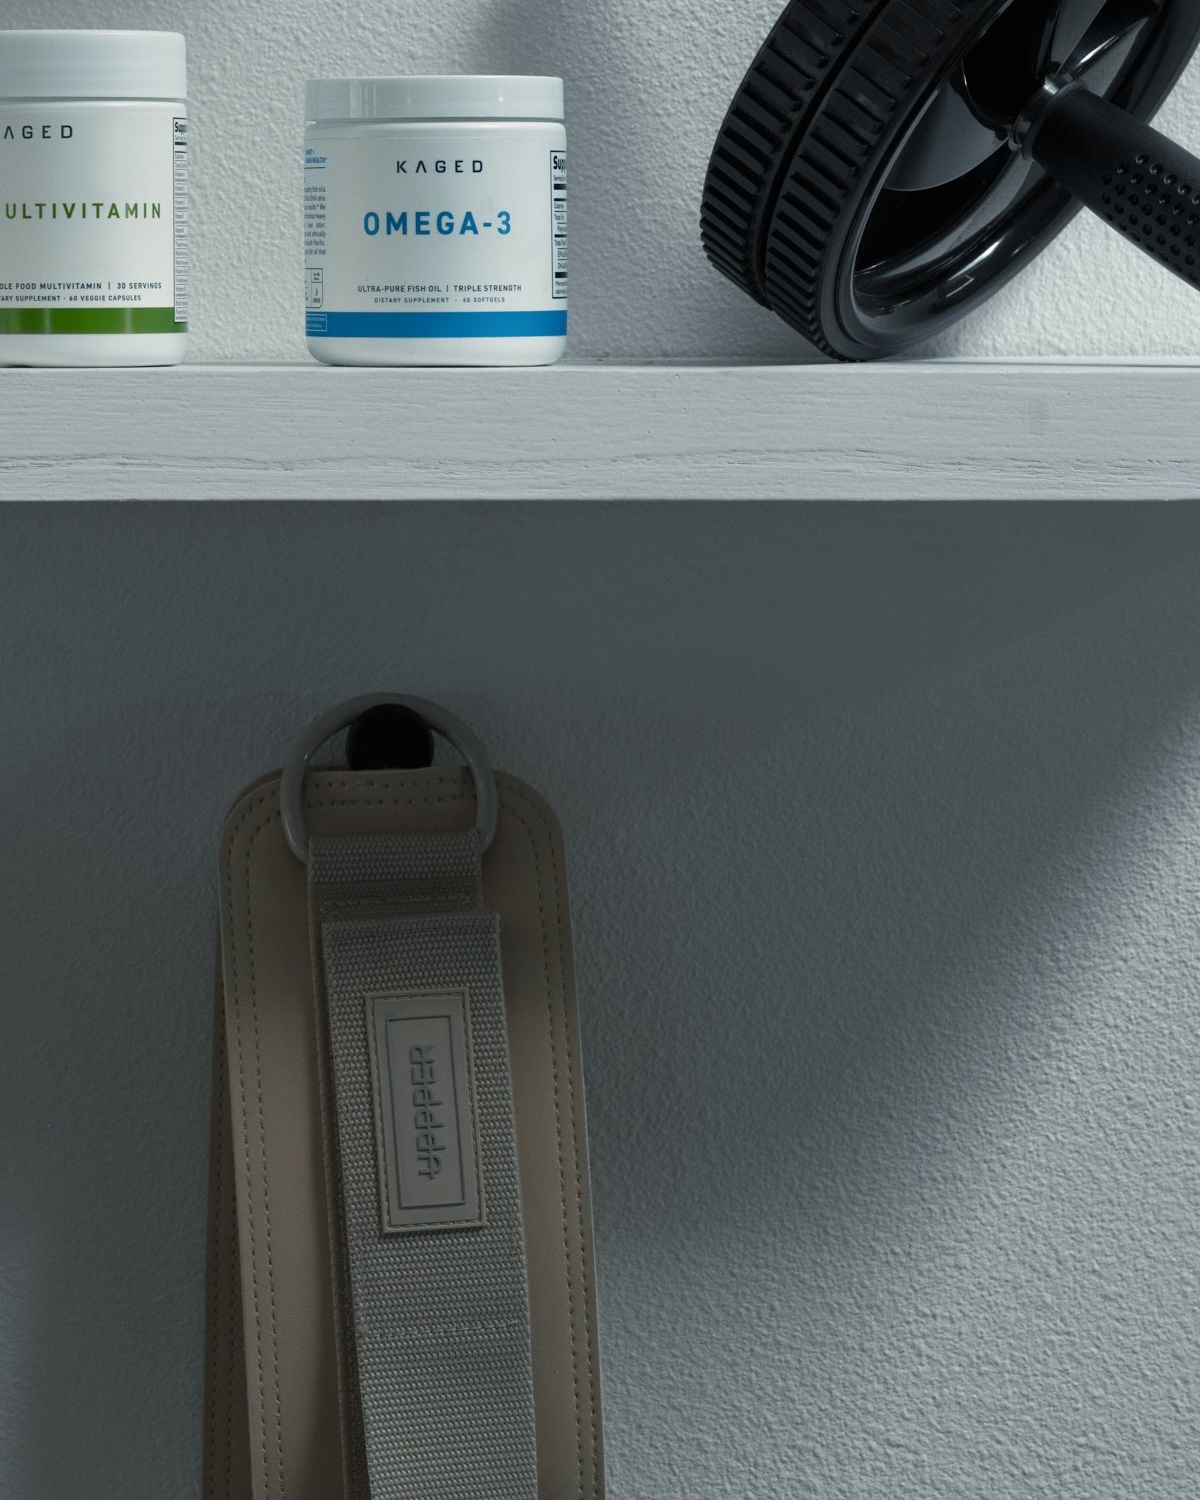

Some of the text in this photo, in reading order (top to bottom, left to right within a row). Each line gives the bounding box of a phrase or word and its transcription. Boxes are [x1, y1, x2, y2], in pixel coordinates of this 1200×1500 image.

[396, 160, 483, 173] KAGED
[364, 211, 511, 236] OMEGA-3
[16, 283, 37, 291] FOOD
[40, 283, 102, 291] MULTIVITAMIN
[129, 282, 162, 290] SERVINGS
[358, 285, 406, 293] ULTRA-PURE
[407, 285, 426, 293] FISH
[428, 285, 442, 293] OIL
[453, 285, 482, 293] TRIPLE
